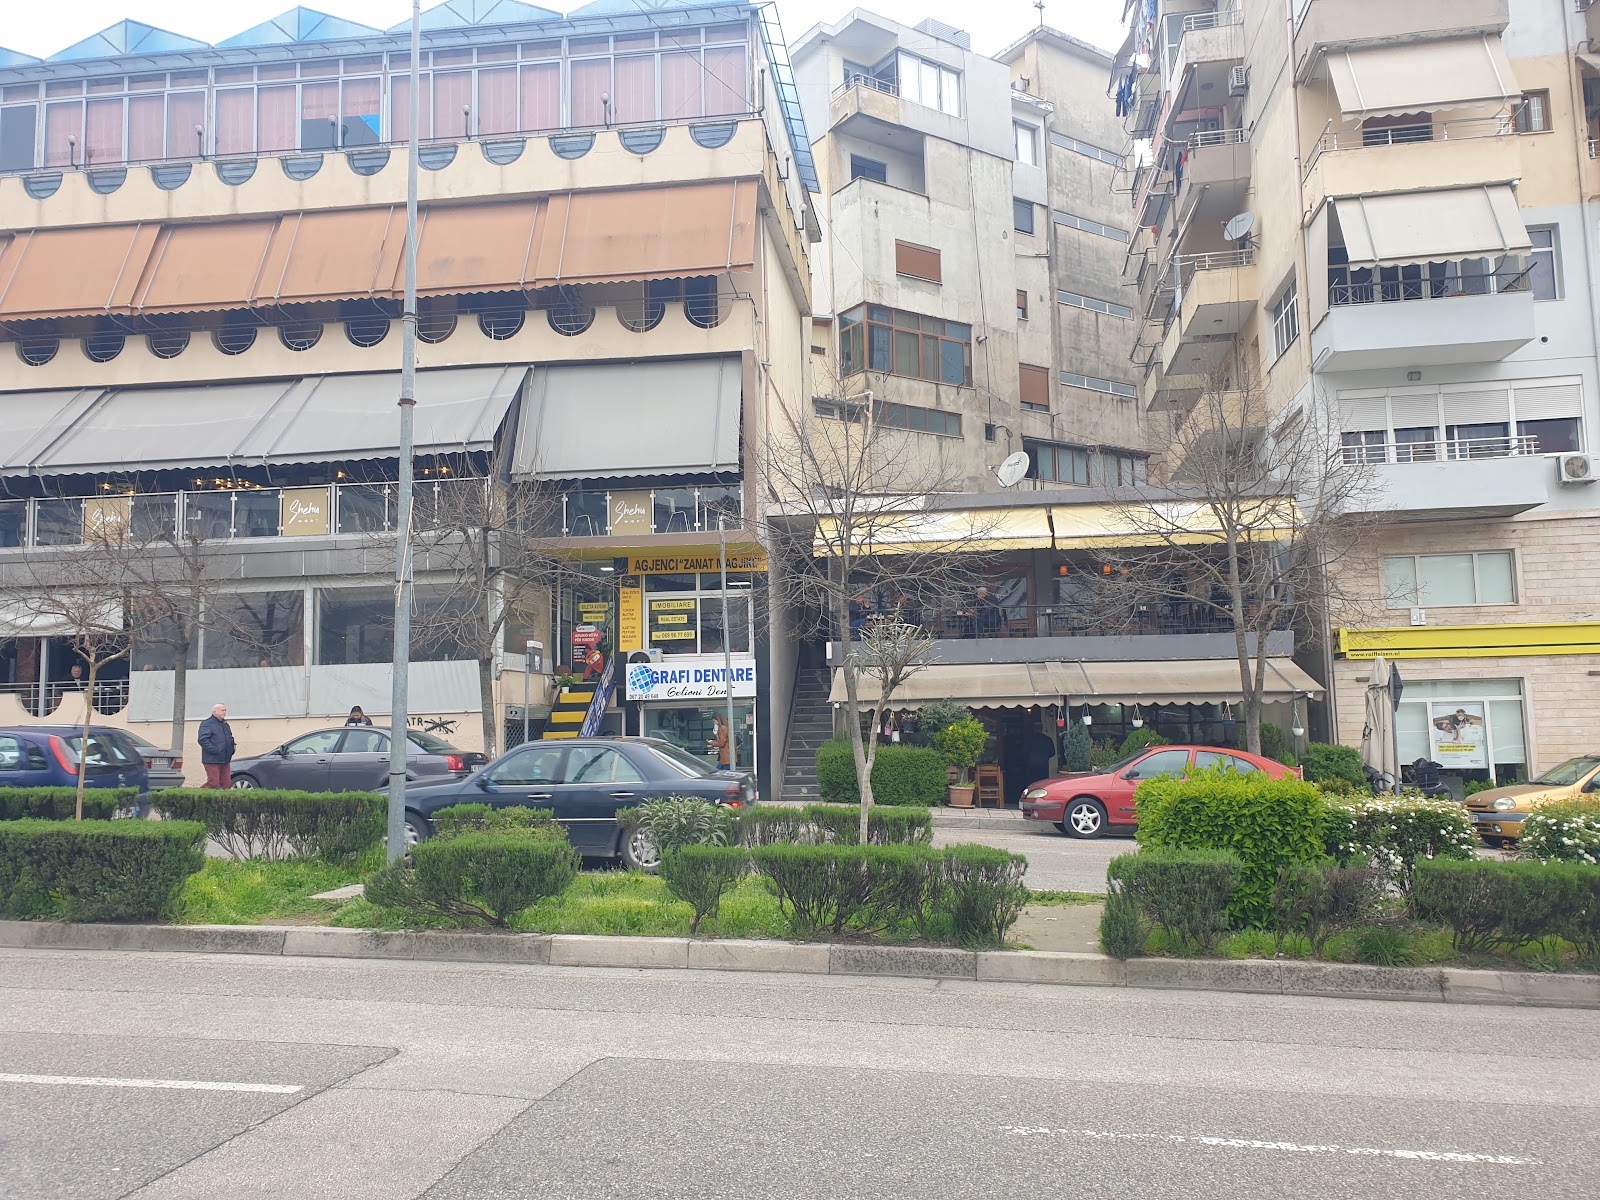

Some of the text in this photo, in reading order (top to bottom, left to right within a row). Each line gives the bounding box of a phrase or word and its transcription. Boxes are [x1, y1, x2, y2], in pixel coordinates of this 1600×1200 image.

[614, 500, 646, 525] Shehu
[634, 559, 679, 572] AGJENCI
[655, 601, 691, 609] IMOBILIARE
[651, 667, 753, 684] GRAFI DENTARE
